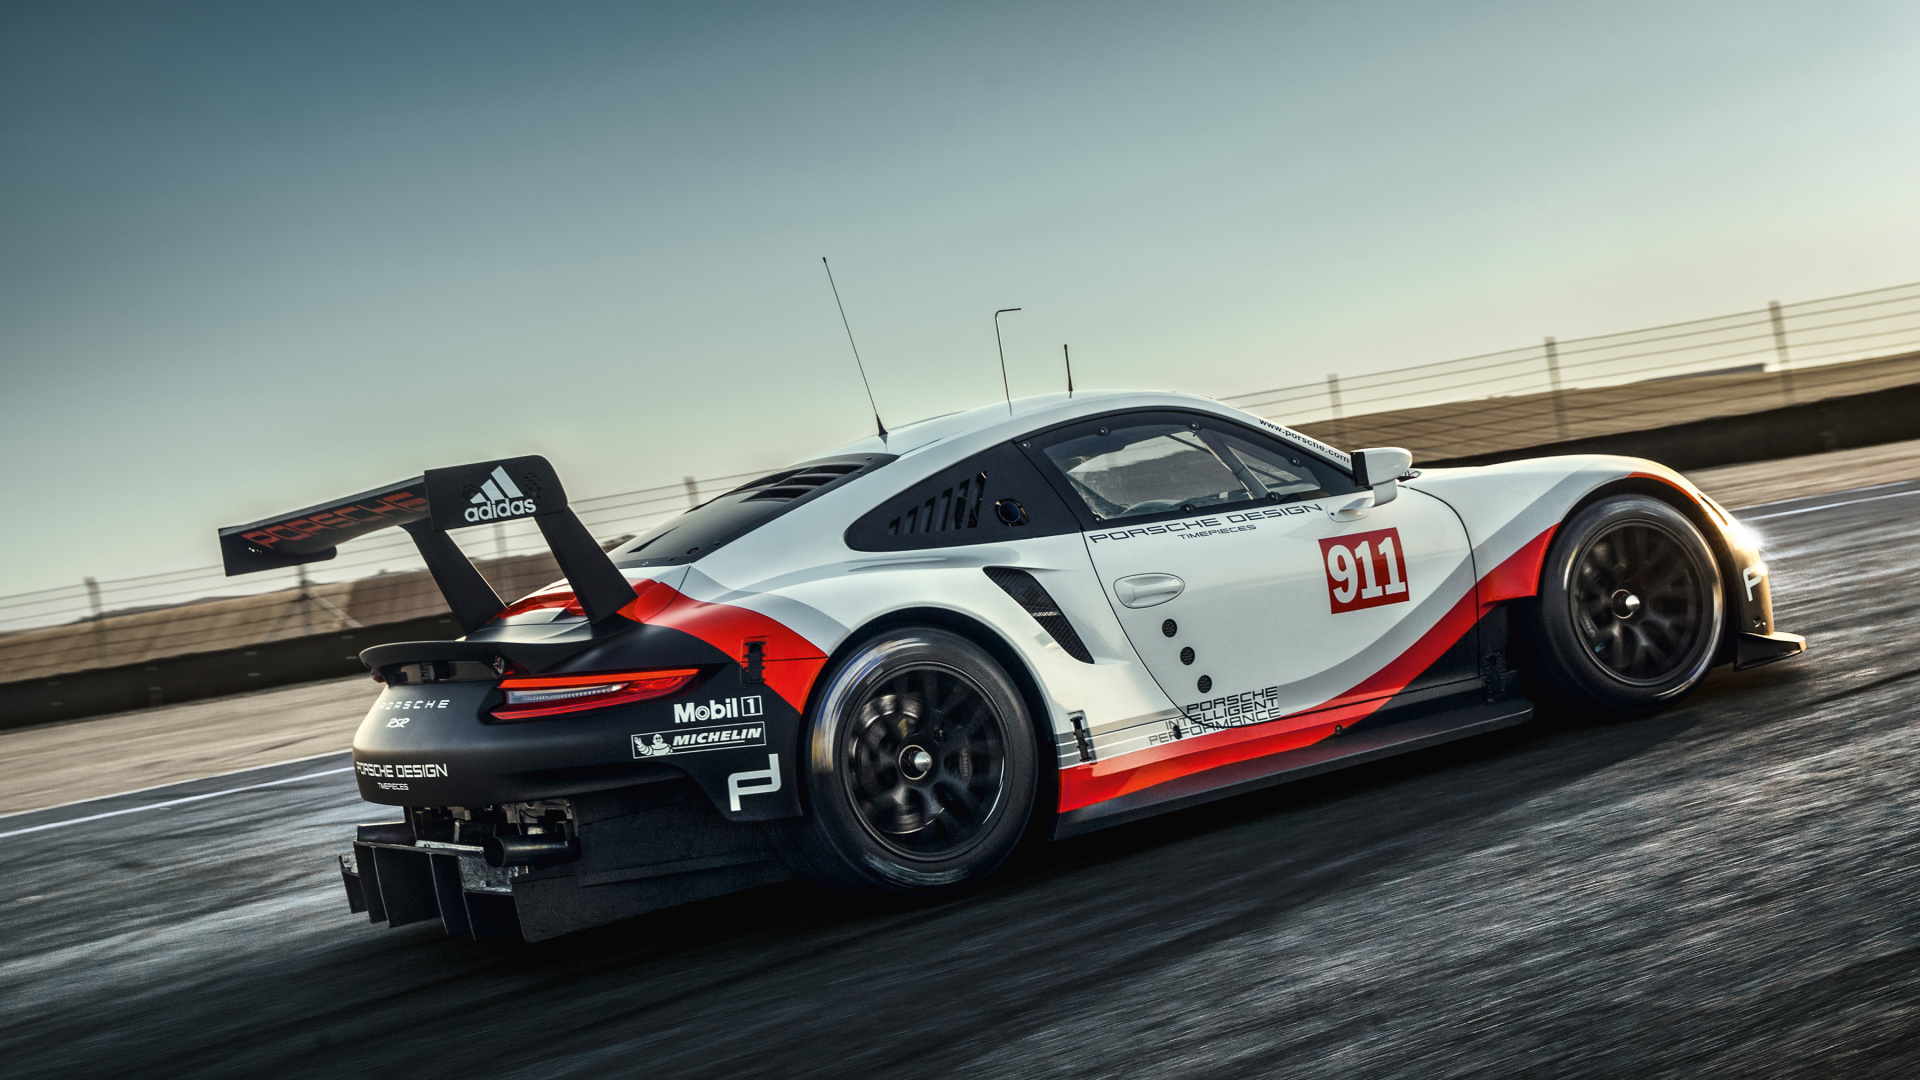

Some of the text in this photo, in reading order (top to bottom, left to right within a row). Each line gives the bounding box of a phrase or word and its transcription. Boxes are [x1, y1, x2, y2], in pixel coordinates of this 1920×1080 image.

[1259, 418, 1350, 463] www.porsche.com
[241, 492, 429, 549] PORSCHE
[464, 497, 537, 523] adidas
[1088, 503, 1324, 544] PORSCHE DESIGN
[1177, 524, 1257, 540] TIMEPIECES
[1327, 536, 1407, 604] 911
[379, 699, 450, 711] PORSCHE
[673, 697, 738, 724] Mobil
[1165, 696, 1278, 730] INTELLIGENT
[1186, 685, 1278, 714] PORSCHE
[672, 727, 762, 746] MICHELIN
[356, 760, 448, 778] PORSCHE DESIGN
